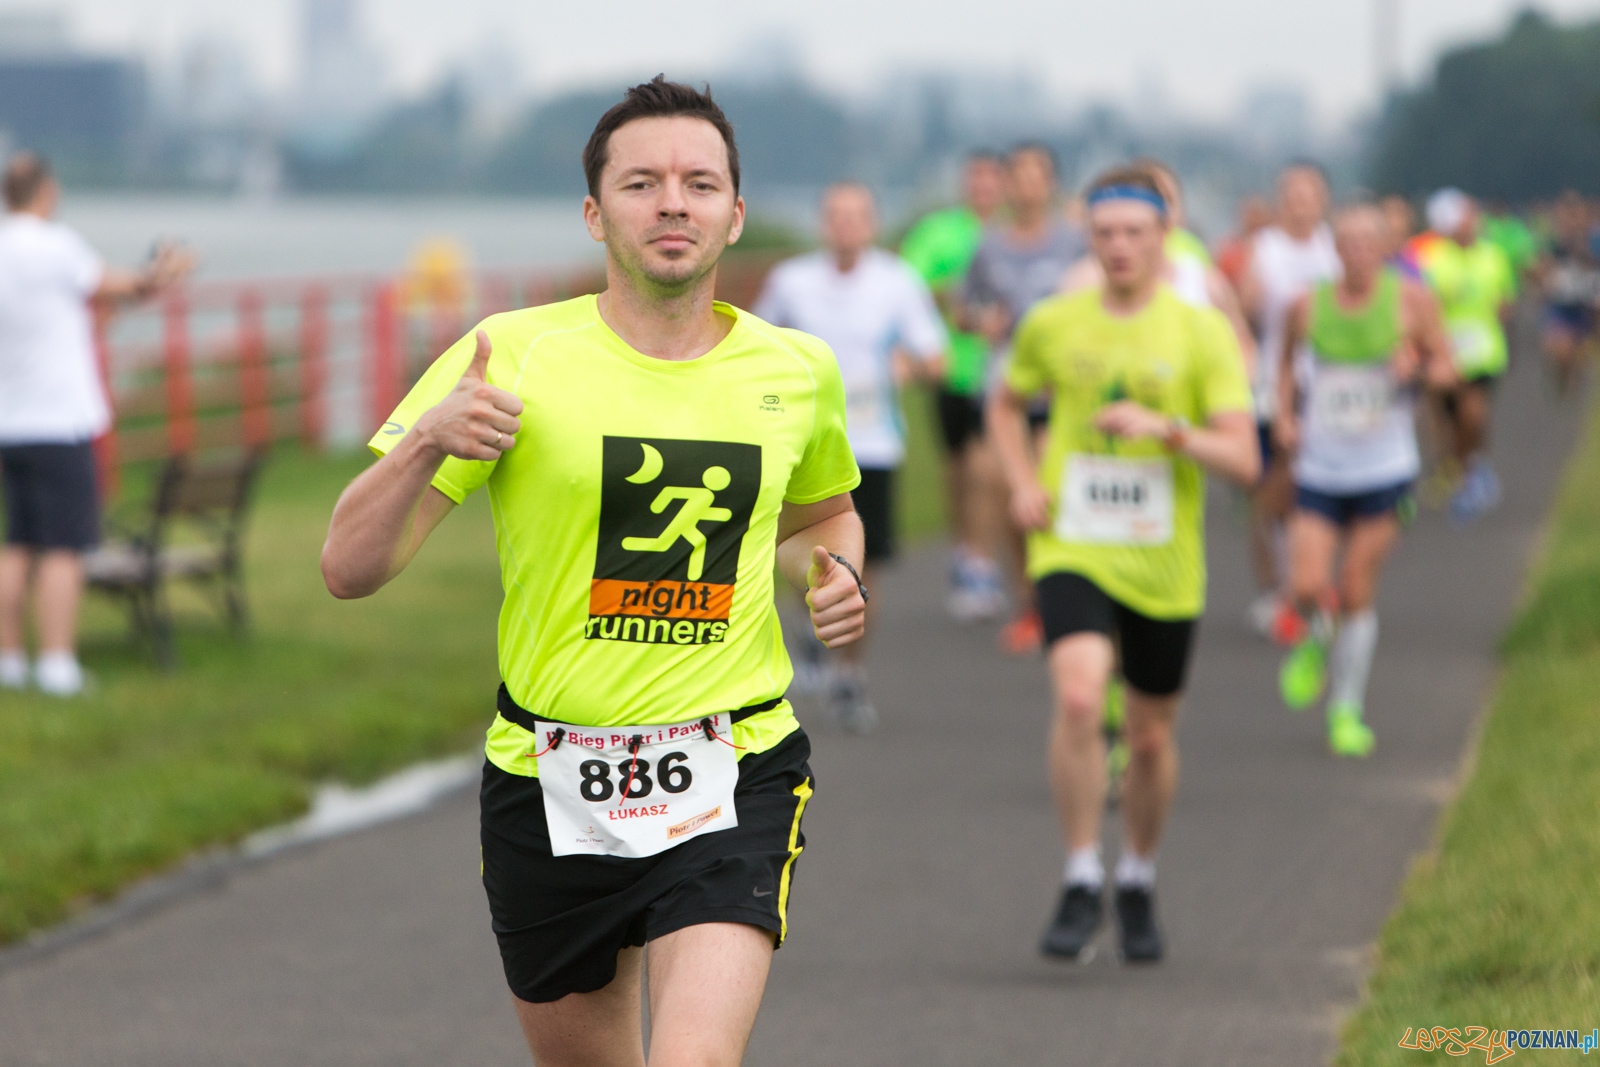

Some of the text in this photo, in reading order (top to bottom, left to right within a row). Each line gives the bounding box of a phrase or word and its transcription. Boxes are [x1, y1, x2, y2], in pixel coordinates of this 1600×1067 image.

[619, 582, 711, 615] night
[585, 616, 728, 644] runners
[568, 732, 605, 749] Bieg
[658, 730, 663, 741] i
[669, 715, 719, 738] Pawł
[579, 751, 692, 802] 886
[608, 804, 668, 820] ŁUKASZ
[670, 824, 691, 835] Piotr
